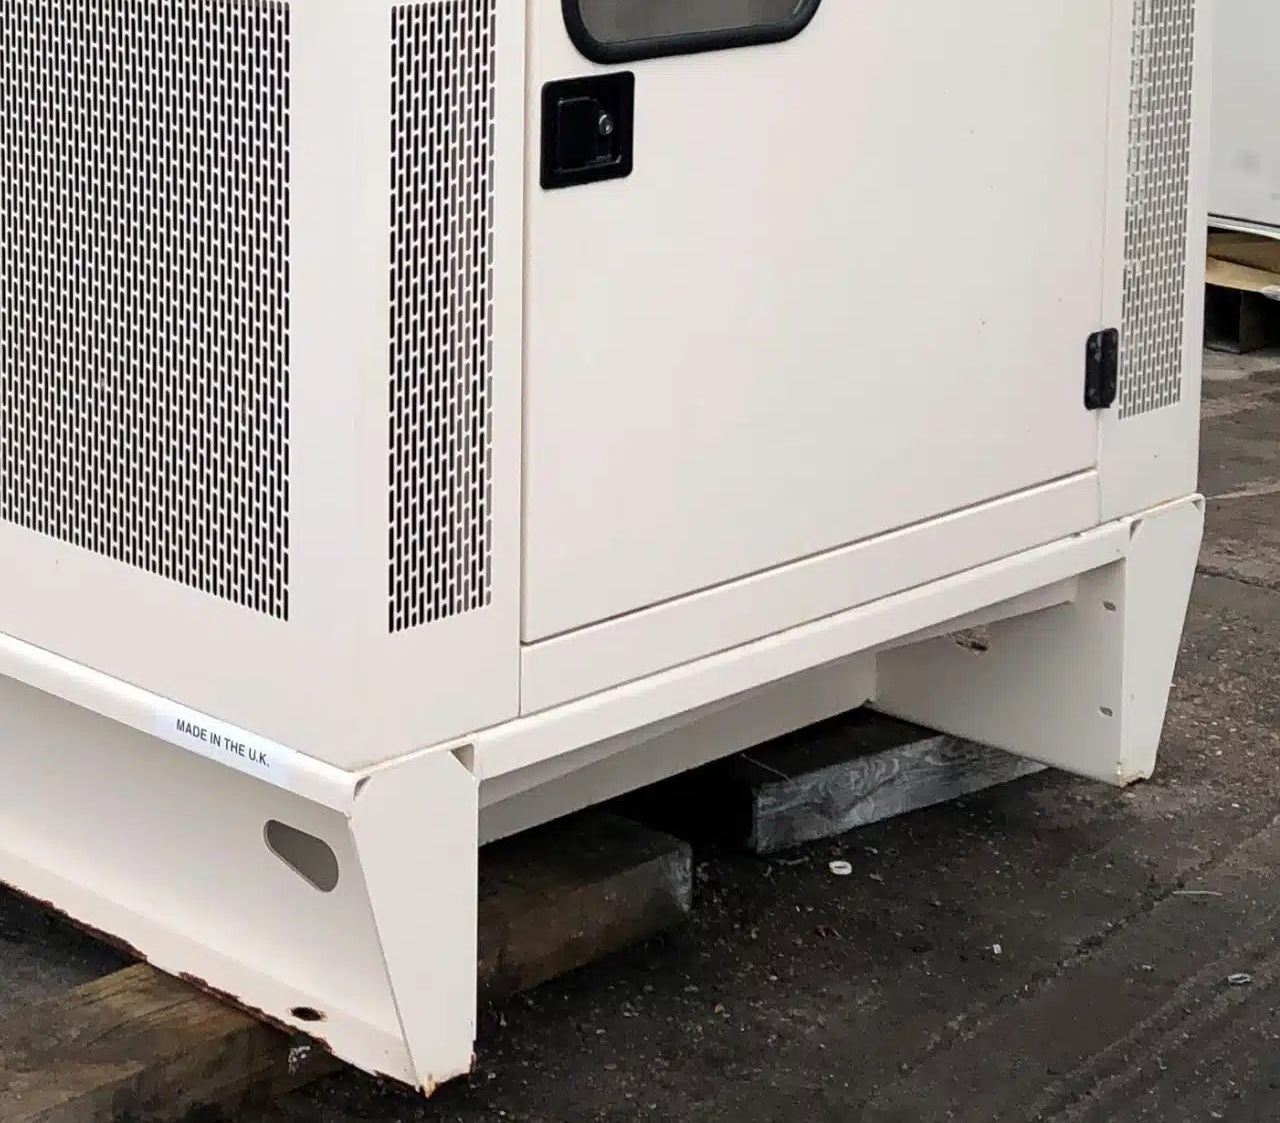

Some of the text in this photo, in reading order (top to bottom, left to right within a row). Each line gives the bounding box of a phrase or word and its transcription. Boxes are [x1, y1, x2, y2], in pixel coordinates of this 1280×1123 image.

[176, 718, 270, 767] MADE IN THE U.K.
